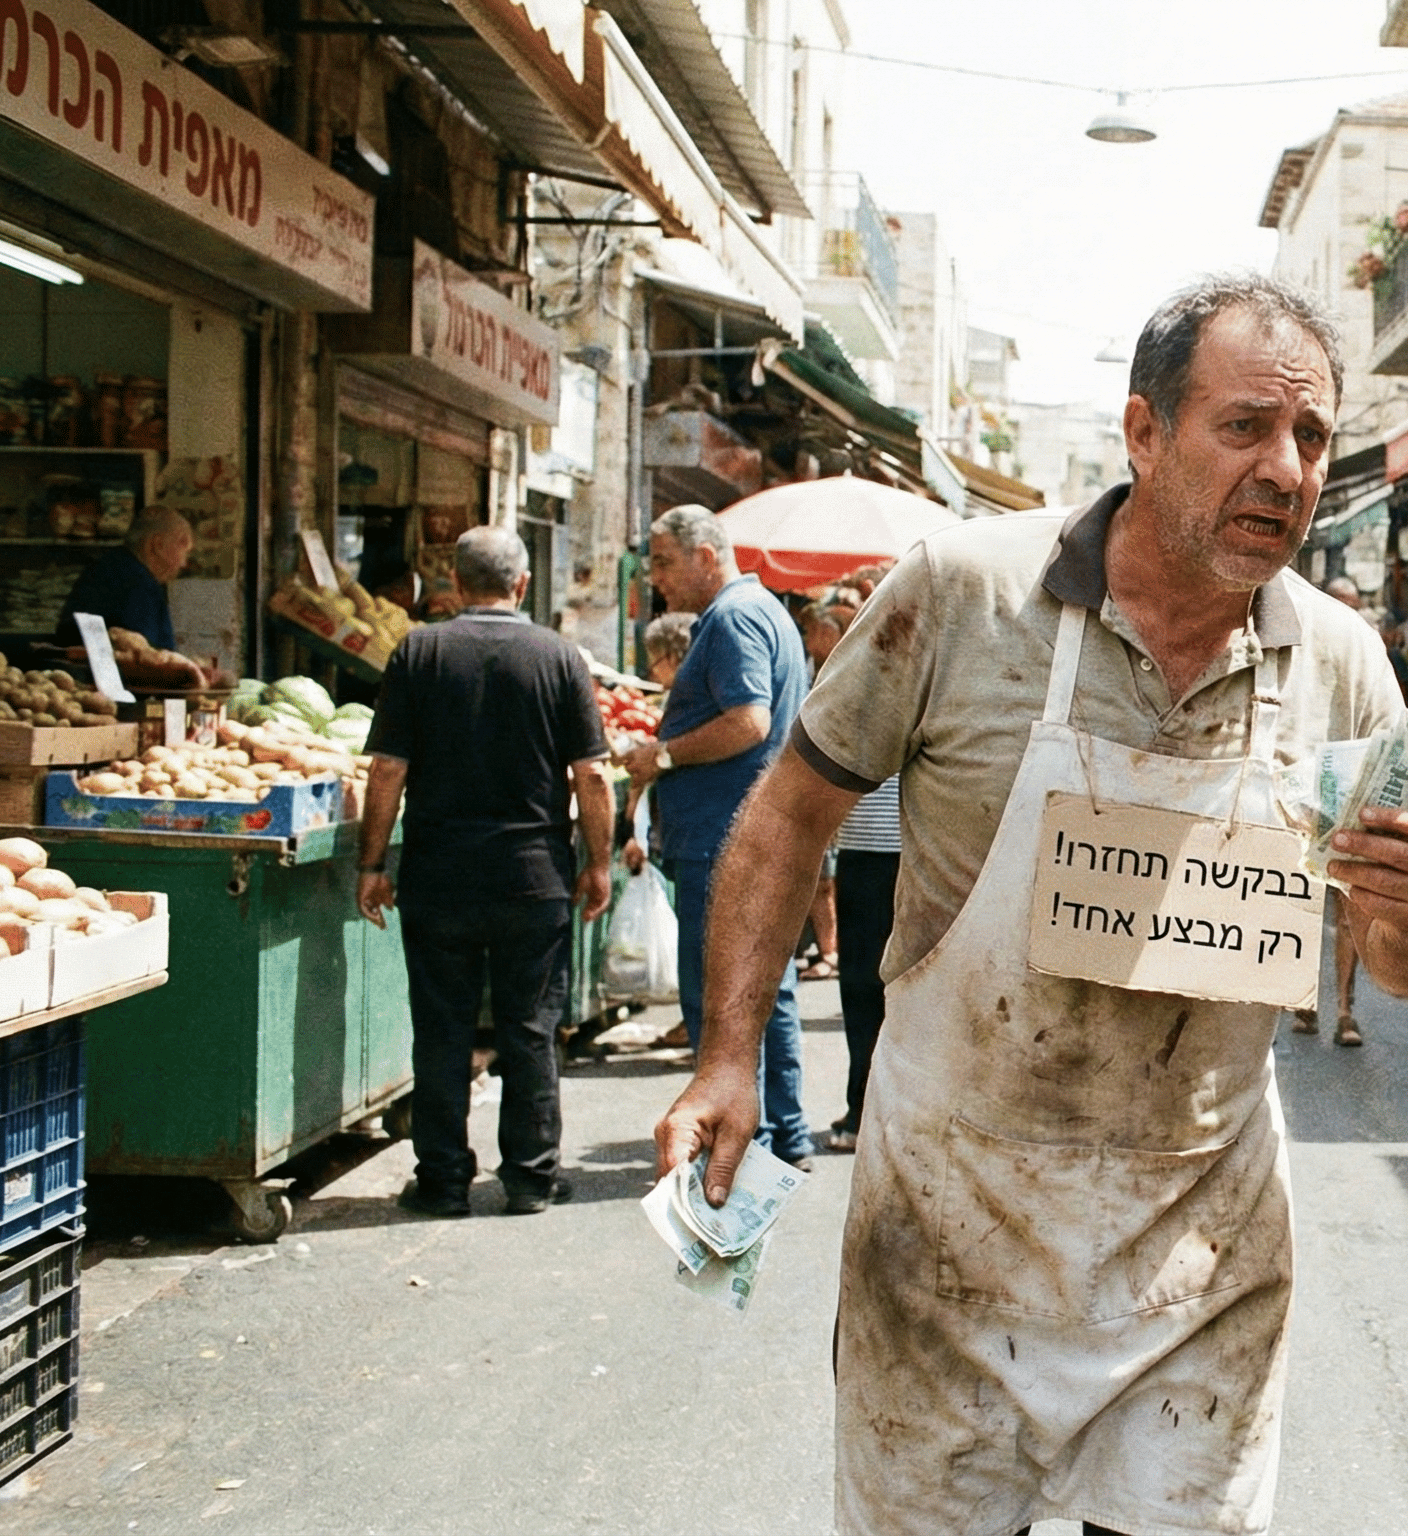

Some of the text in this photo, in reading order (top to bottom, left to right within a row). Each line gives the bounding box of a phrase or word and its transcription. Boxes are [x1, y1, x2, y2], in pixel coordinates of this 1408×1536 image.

[0, 0, 262, 228] מאפית הכרמ
[1054, 830, 1312, 901] בבקשה תחזרו!
[1051, 891, 1302, 964] רק מבצע אחד!
